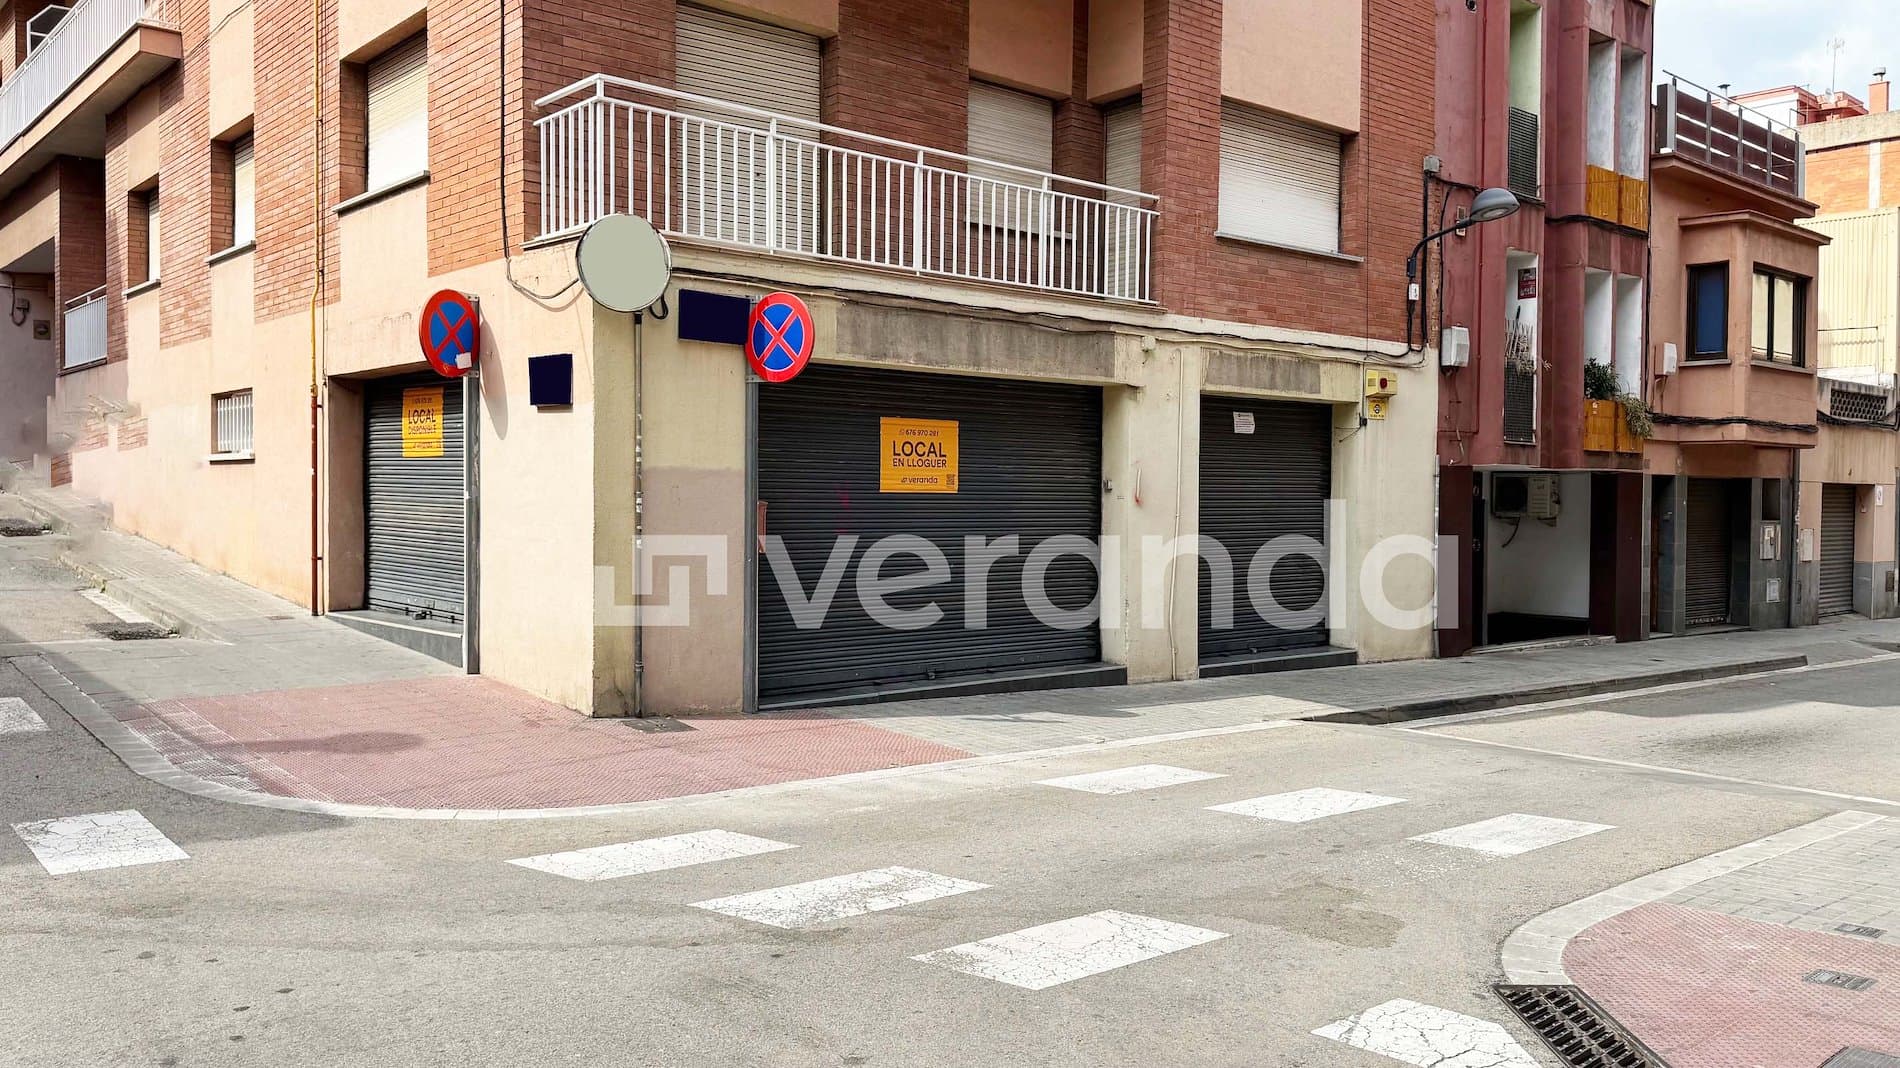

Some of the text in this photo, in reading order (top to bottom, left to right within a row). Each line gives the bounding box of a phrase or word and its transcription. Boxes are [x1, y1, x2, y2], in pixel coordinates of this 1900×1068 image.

[408, 408, 436, 424] LOCAL
[893, 440, 946, 458] LOCAL
[893, 458, 946, 468] EN LLOGUER
[909, 476, 938, 484] veranda
